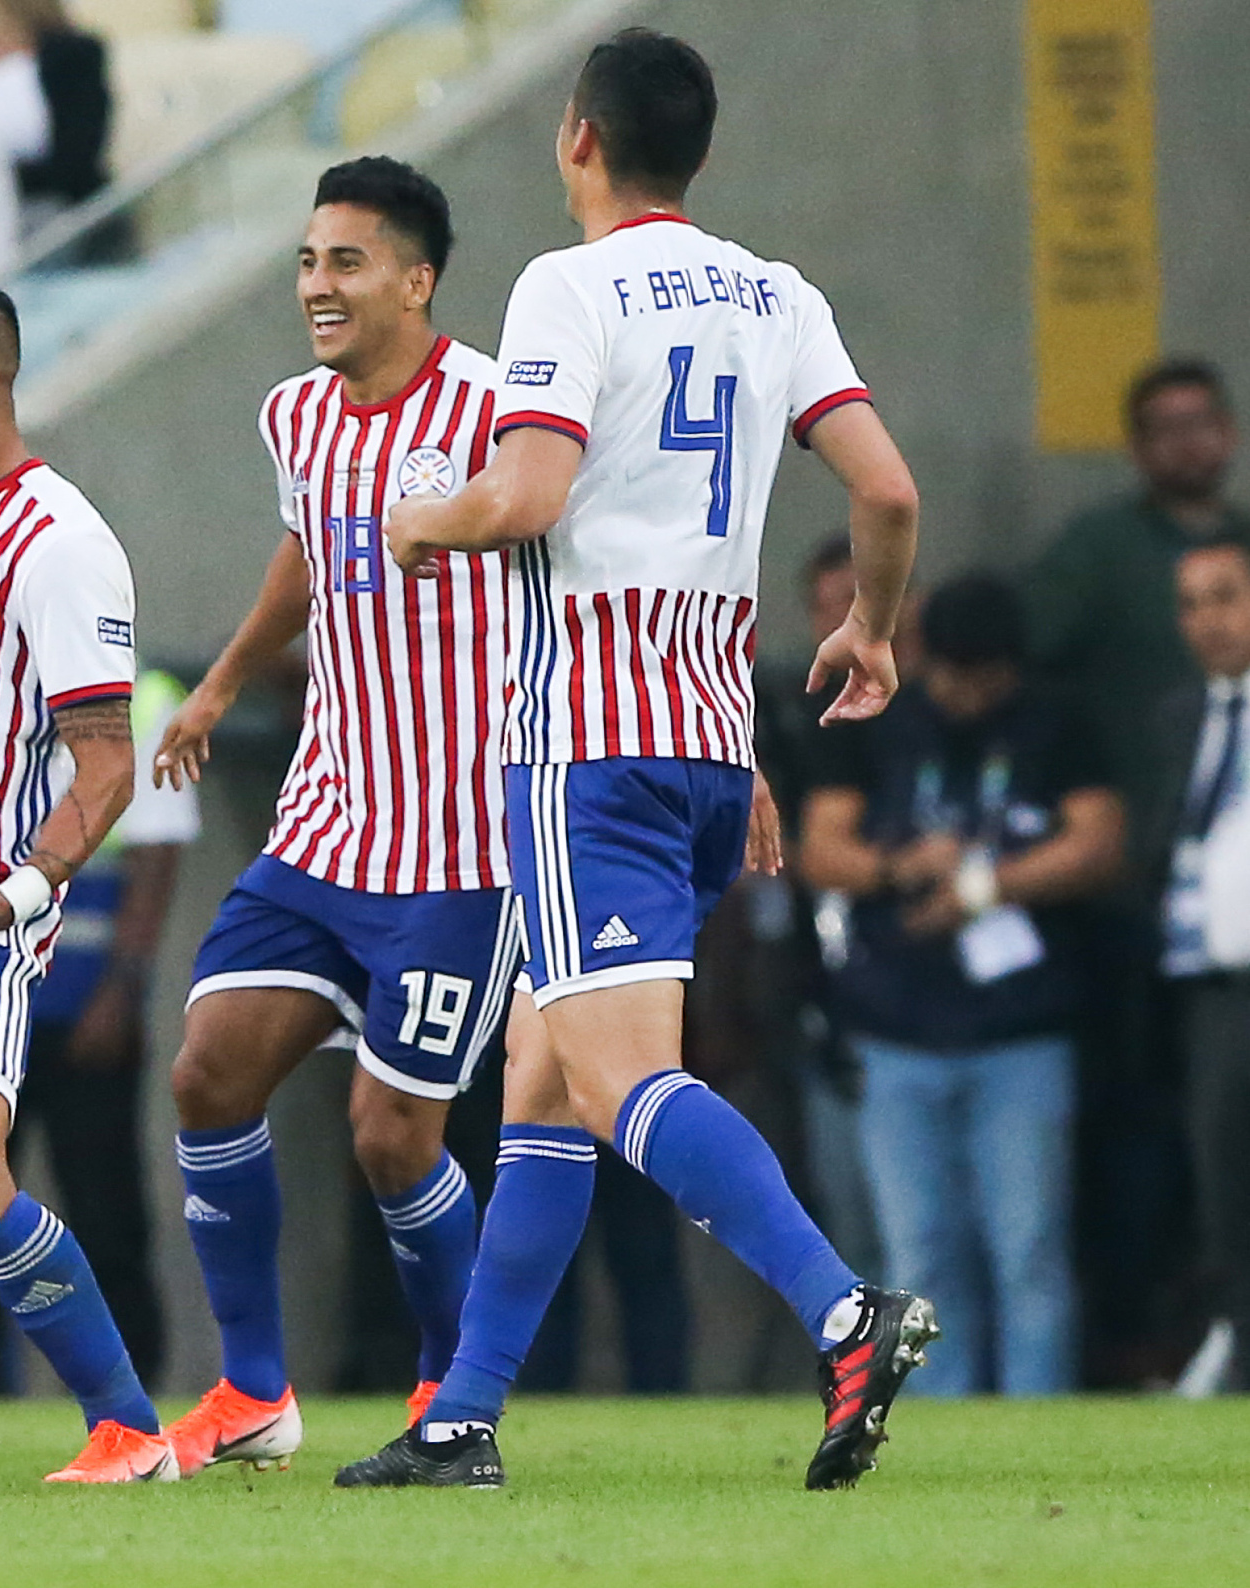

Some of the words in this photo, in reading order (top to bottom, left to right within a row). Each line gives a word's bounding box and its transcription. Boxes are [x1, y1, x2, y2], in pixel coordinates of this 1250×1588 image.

[613, 278, 644, 317] F.
[659, 345, 737, 538] 4
[591, 933, 639, 950] adidas
[397, 969, 474, 1057] 19
